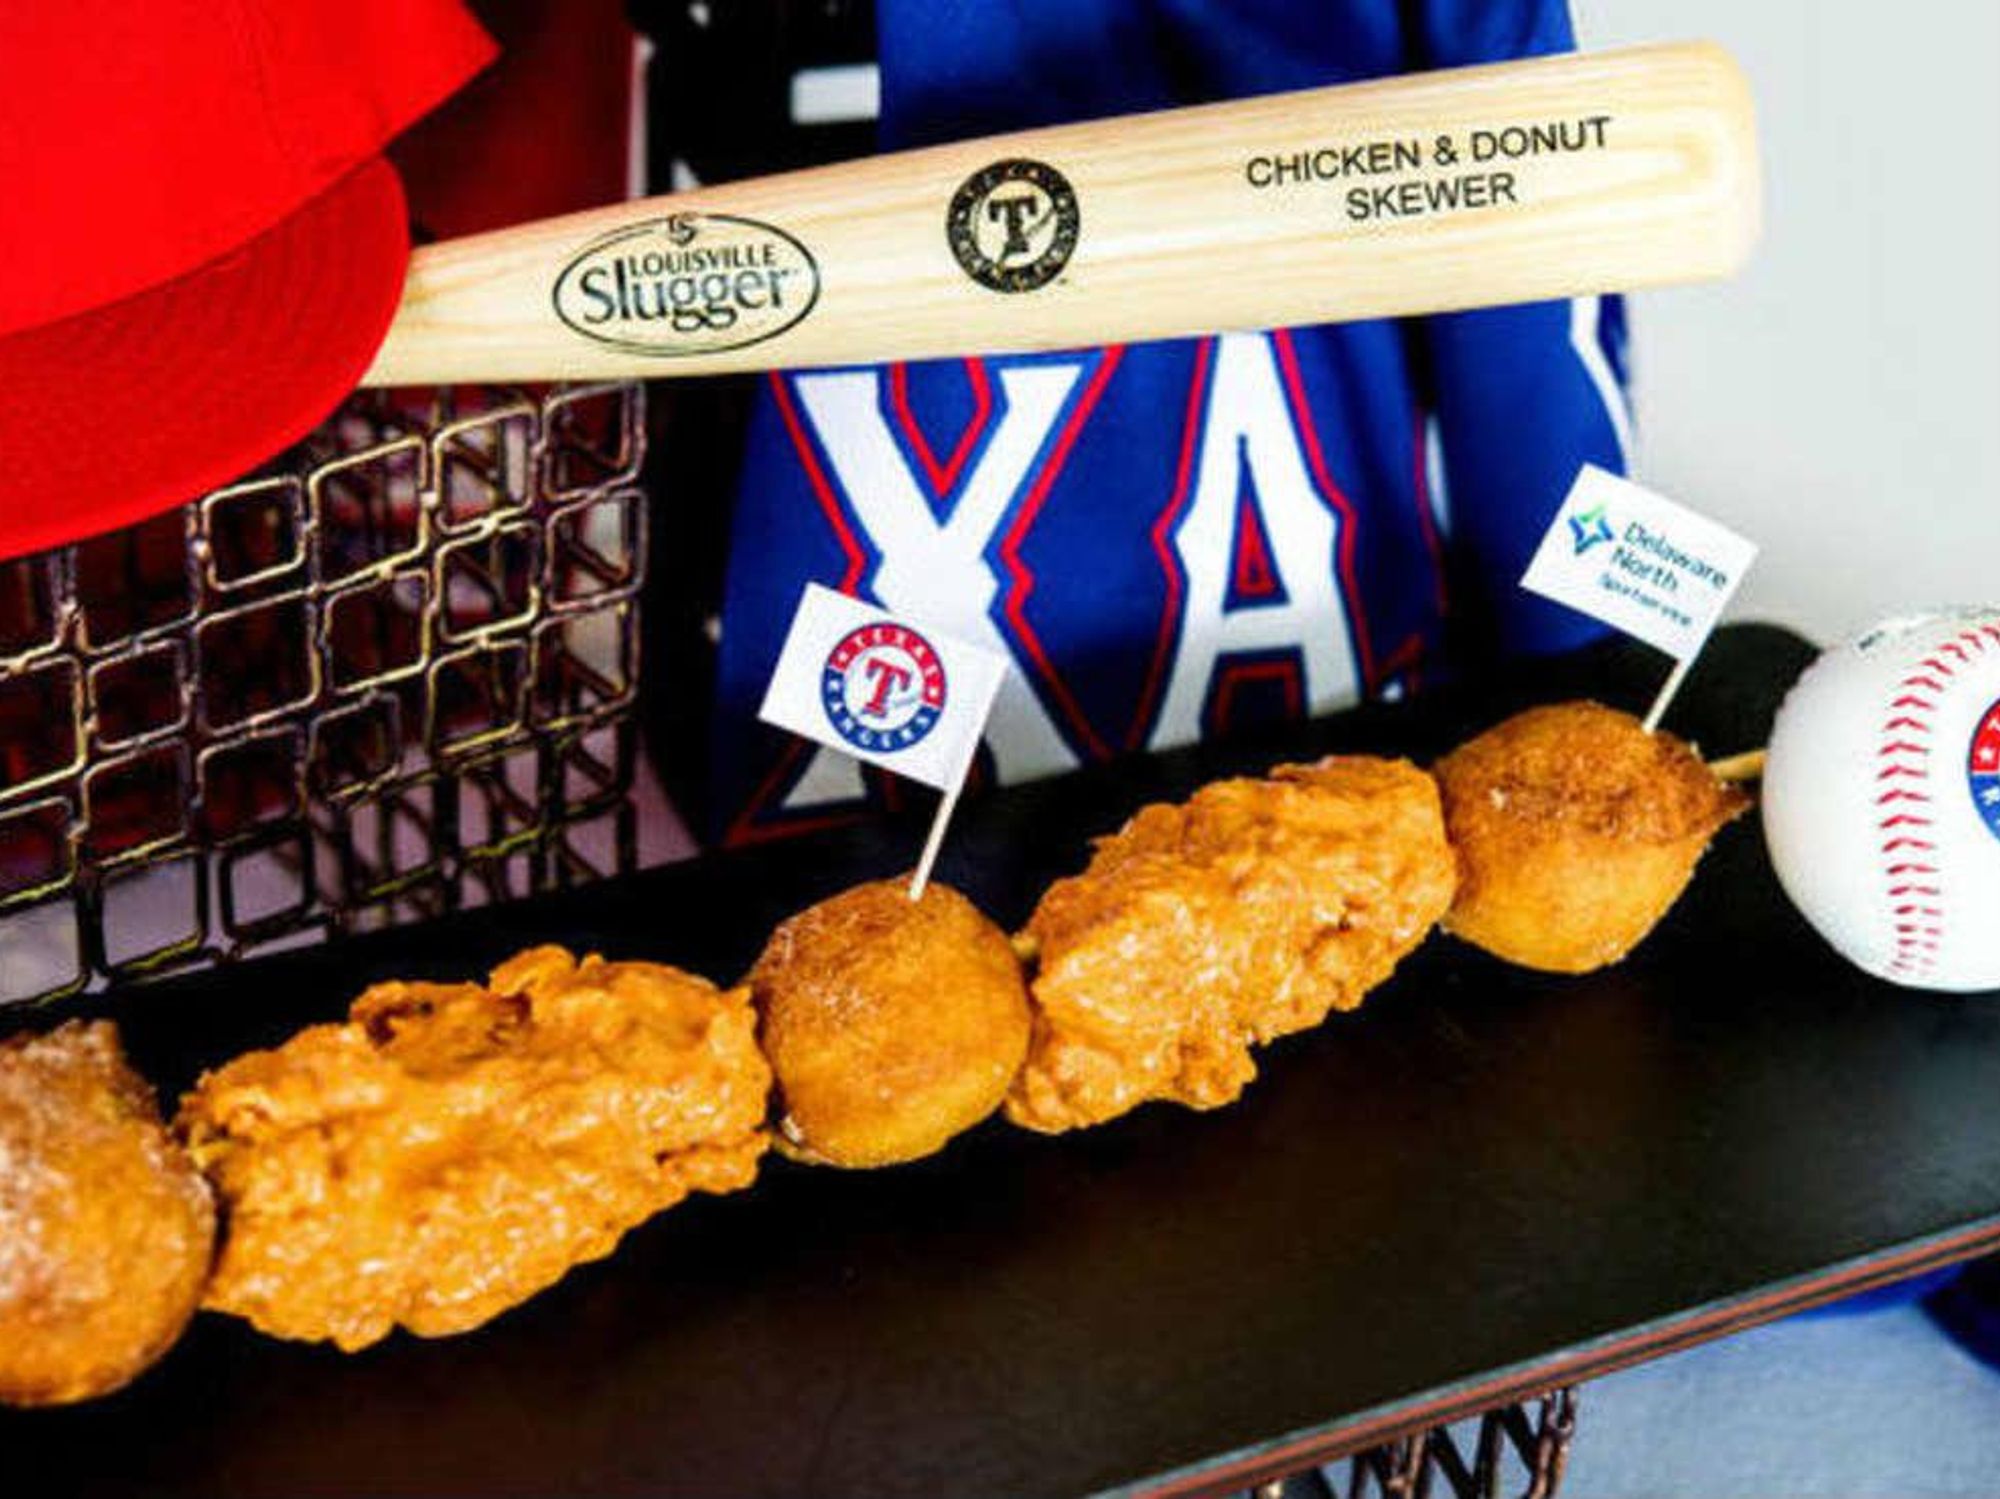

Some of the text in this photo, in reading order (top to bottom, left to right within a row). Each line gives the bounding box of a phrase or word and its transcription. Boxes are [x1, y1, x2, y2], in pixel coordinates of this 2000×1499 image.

[1245, 116, 1613, 189] CHICKEN & DONUT
[1346, 171, 1518, 221] SKEWER
[629, 243, 779, 278] LOUISVILLE
[578, 258, 790, 332] Slugger
[1609, 546, 1679, 592] North
[1623, 520, 1728, 589] Delaware
[861, 657, 912, 719] T
